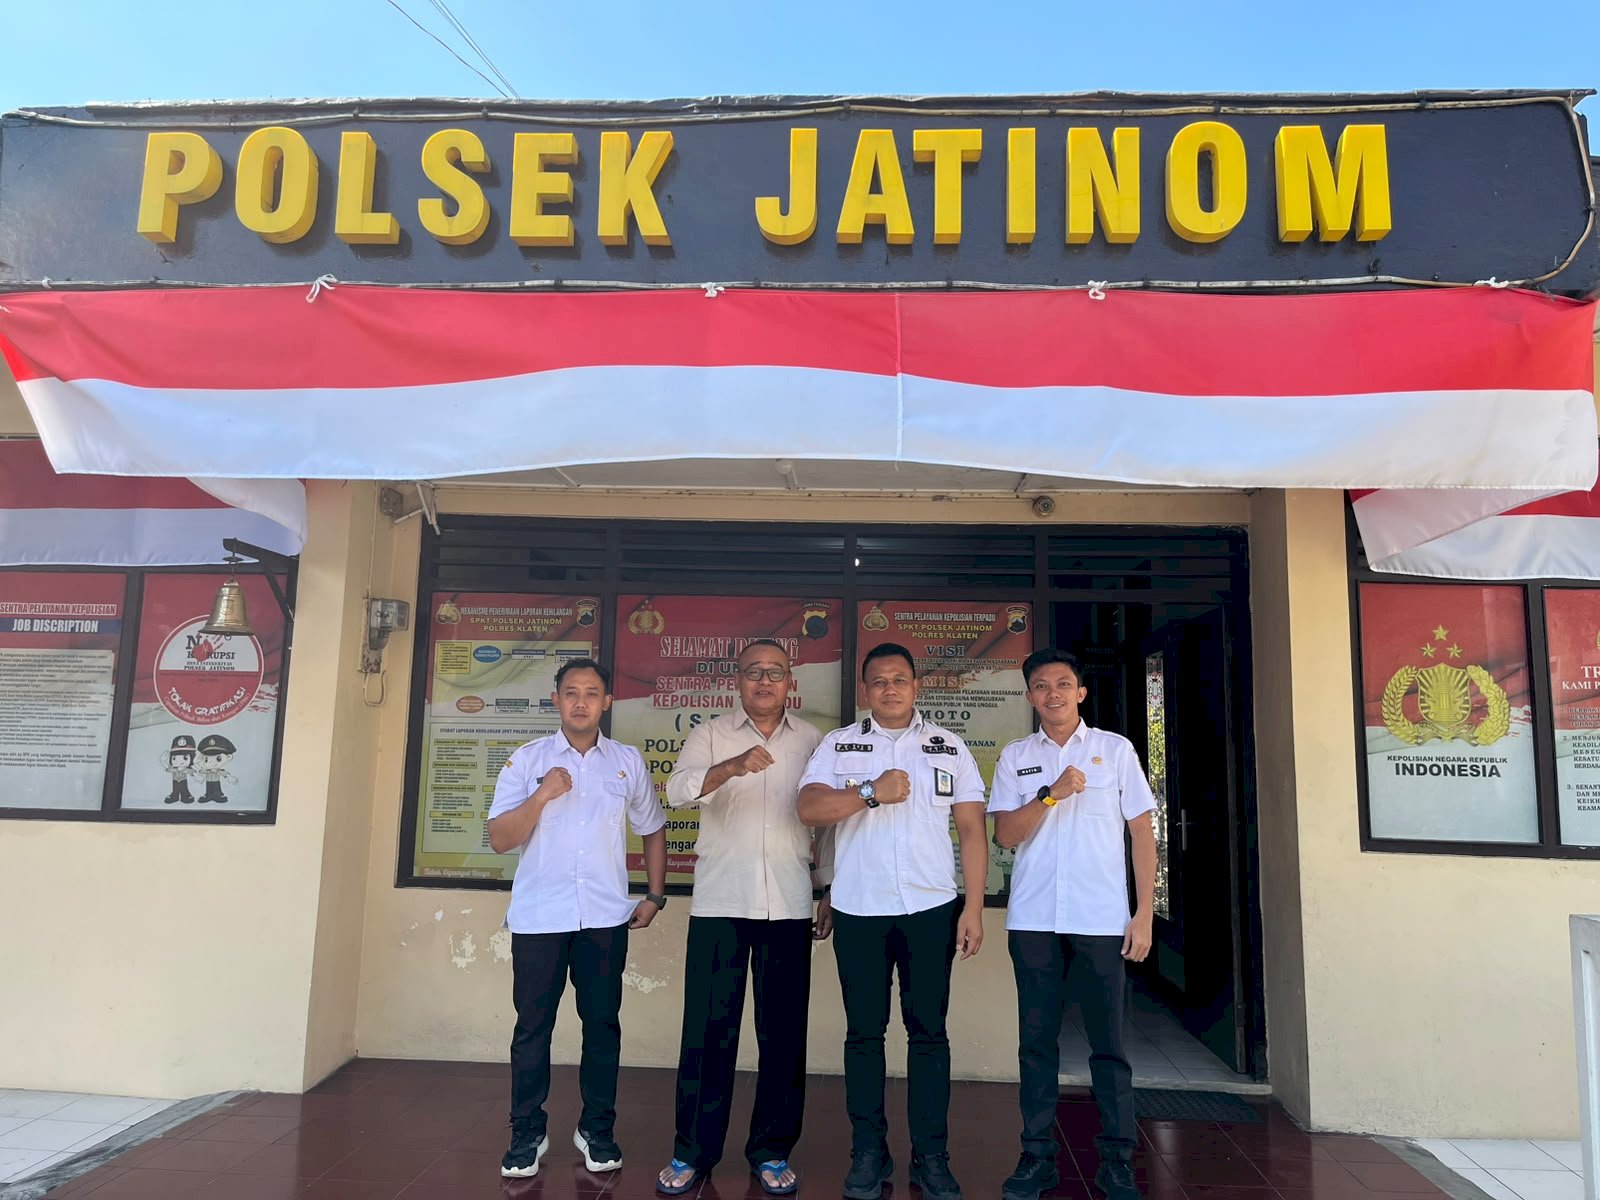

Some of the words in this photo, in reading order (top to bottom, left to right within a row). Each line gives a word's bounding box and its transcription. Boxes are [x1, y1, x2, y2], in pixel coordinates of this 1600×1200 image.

[137, 127, 674, 246] POLSEK
[754, 120, 1392, 246] JATINOM
[0, 602, 28, 614] SENTRA
[28, 603, 70, 615] PELAYANAN
[70, 604, 117, 615] KEPOLISIAN
[521, 608, 542, 616] LAPORAN
[944, 613, 972, 621] KEPOLISIAN
[13, 619, 31, 631] JOB
[33, 619, 99, 632] DISCRIPTION
[660, 636, 730, 658] SELAMAT
[925, 646, 966, 656] VISI
[187, 651, 235, 660] KRUPSI
[696, 661, 714, 674] DI
[656, 676, 712, 691] SENTRA
[922, 676, 965, 687] MISI
[1562, 681, 1591, 689] KAMI
[168, 687, 192, 712] TOLAK
[195, 686, 246, 716] GRATIFIKASI
[653, 694, 733, 708] KEPOLISIAN
[919, 710, 971, 720] MOTO
[1395, 763, 1501, 777] INDONESIA
